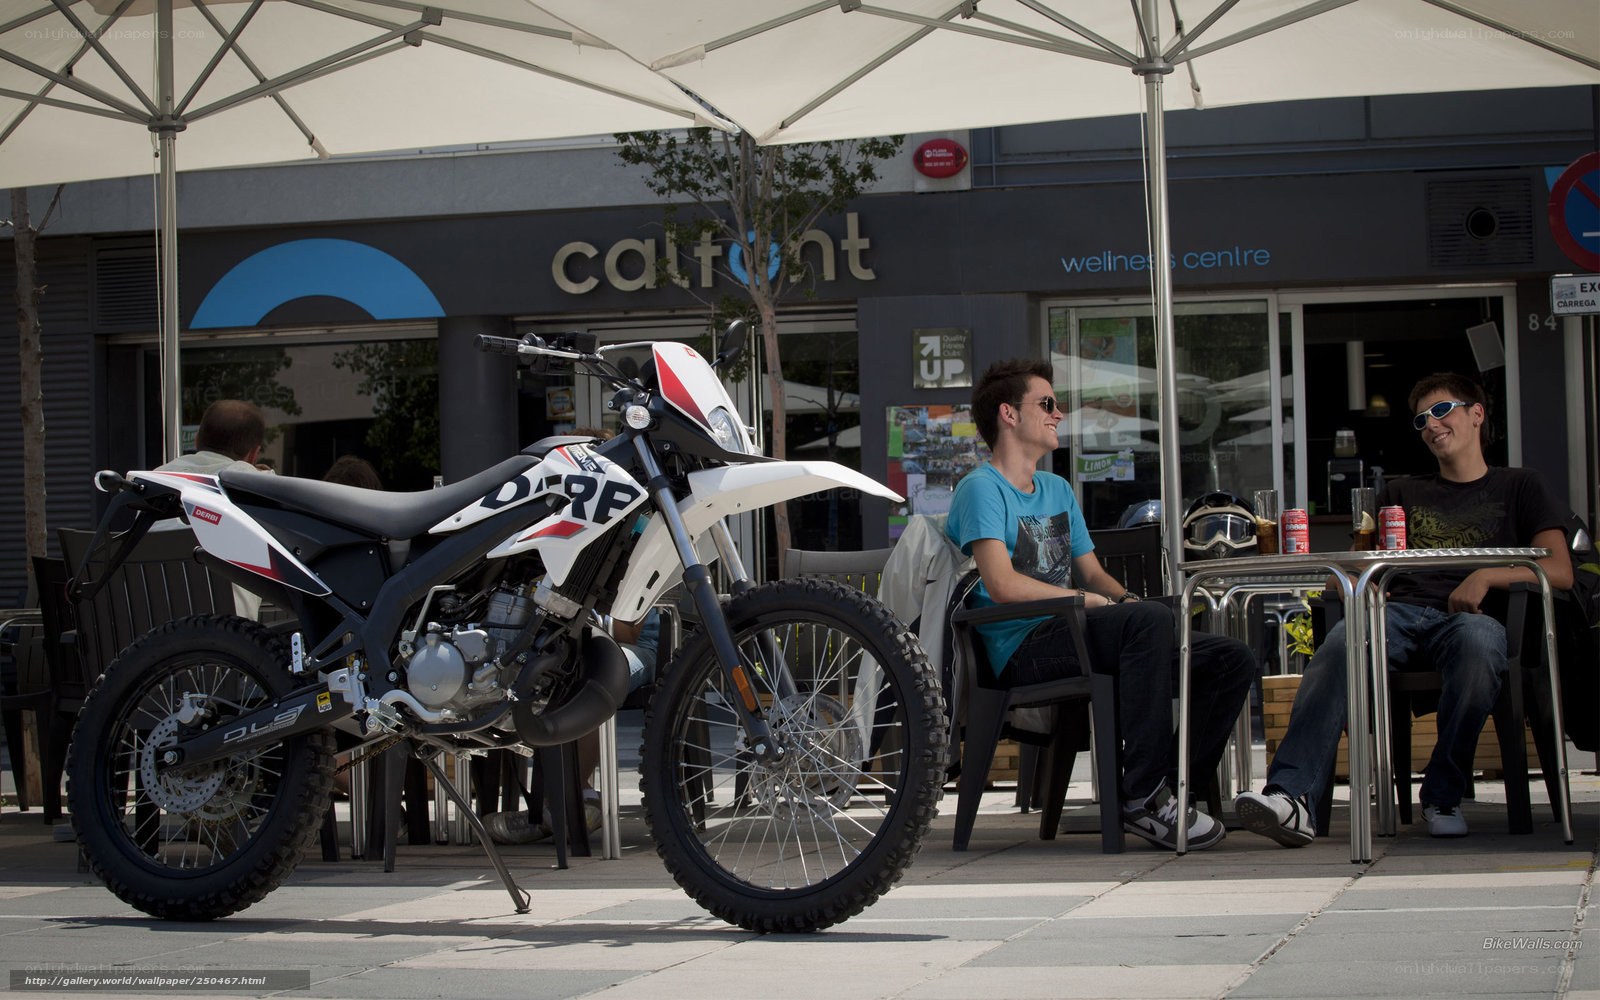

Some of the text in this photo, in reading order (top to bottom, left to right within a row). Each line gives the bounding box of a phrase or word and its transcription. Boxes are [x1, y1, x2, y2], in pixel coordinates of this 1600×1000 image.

[1528, 313, 1558, 332] 84
[919, 358, 965, 381] UP
[1083, 457, 1112, 472] LIMON
[195, 508, 219, 522] DERBI
[223, 704, 304, 744] DLS
